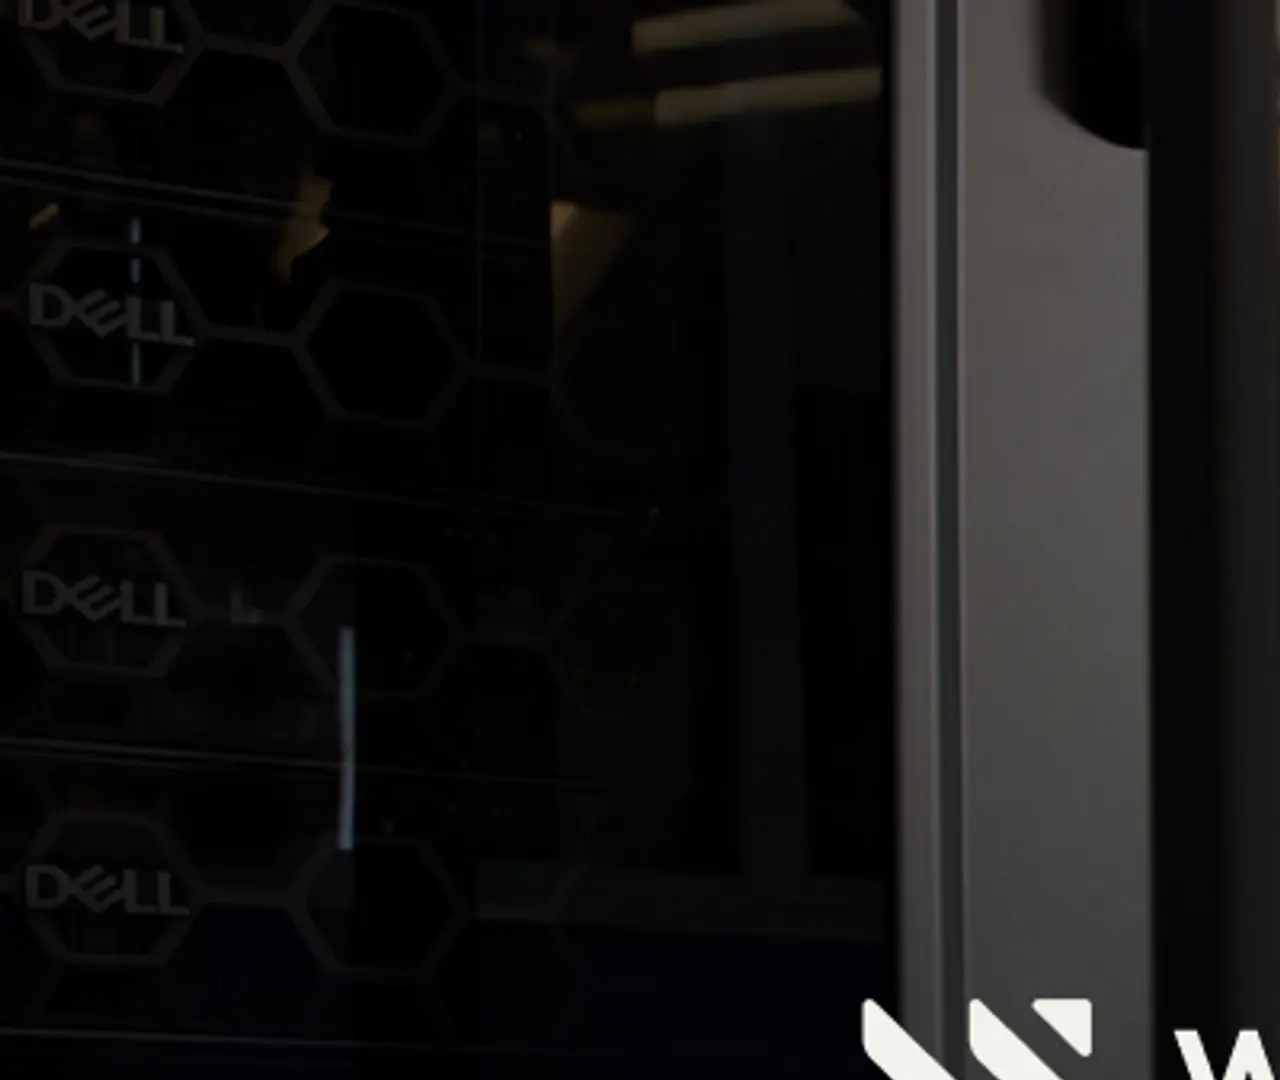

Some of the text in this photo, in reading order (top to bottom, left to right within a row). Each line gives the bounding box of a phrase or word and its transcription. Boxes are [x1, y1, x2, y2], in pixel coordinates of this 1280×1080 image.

[18, 0, 185, 53] DELL
[28, 281, 196, 347] DELL
[21, 569, 188, 629] DELL
[25, 863, 191, 916] DELL
